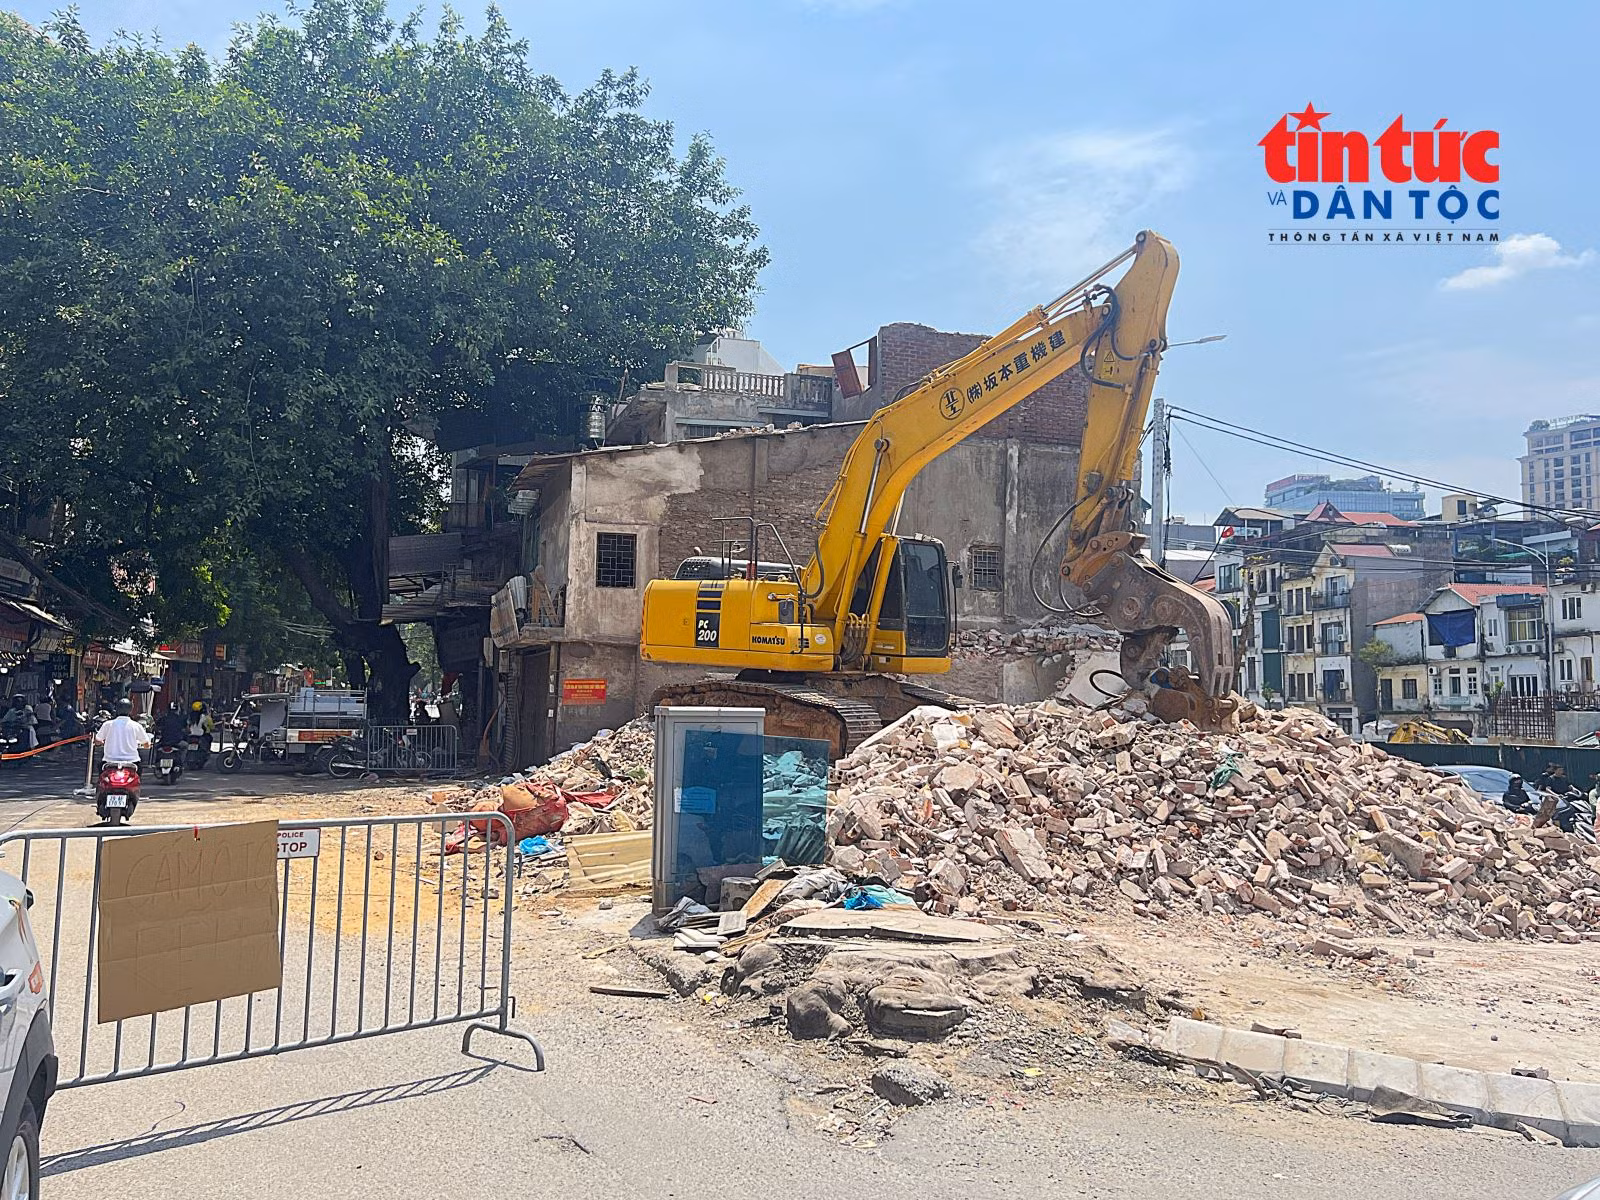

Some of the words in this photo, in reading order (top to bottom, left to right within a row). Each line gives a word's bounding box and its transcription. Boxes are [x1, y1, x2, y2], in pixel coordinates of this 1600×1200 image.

[697, 619, 709, 629] PC
[697, 630, 717, 641] 200
[751, 635, 785, 646] KOMATSU
